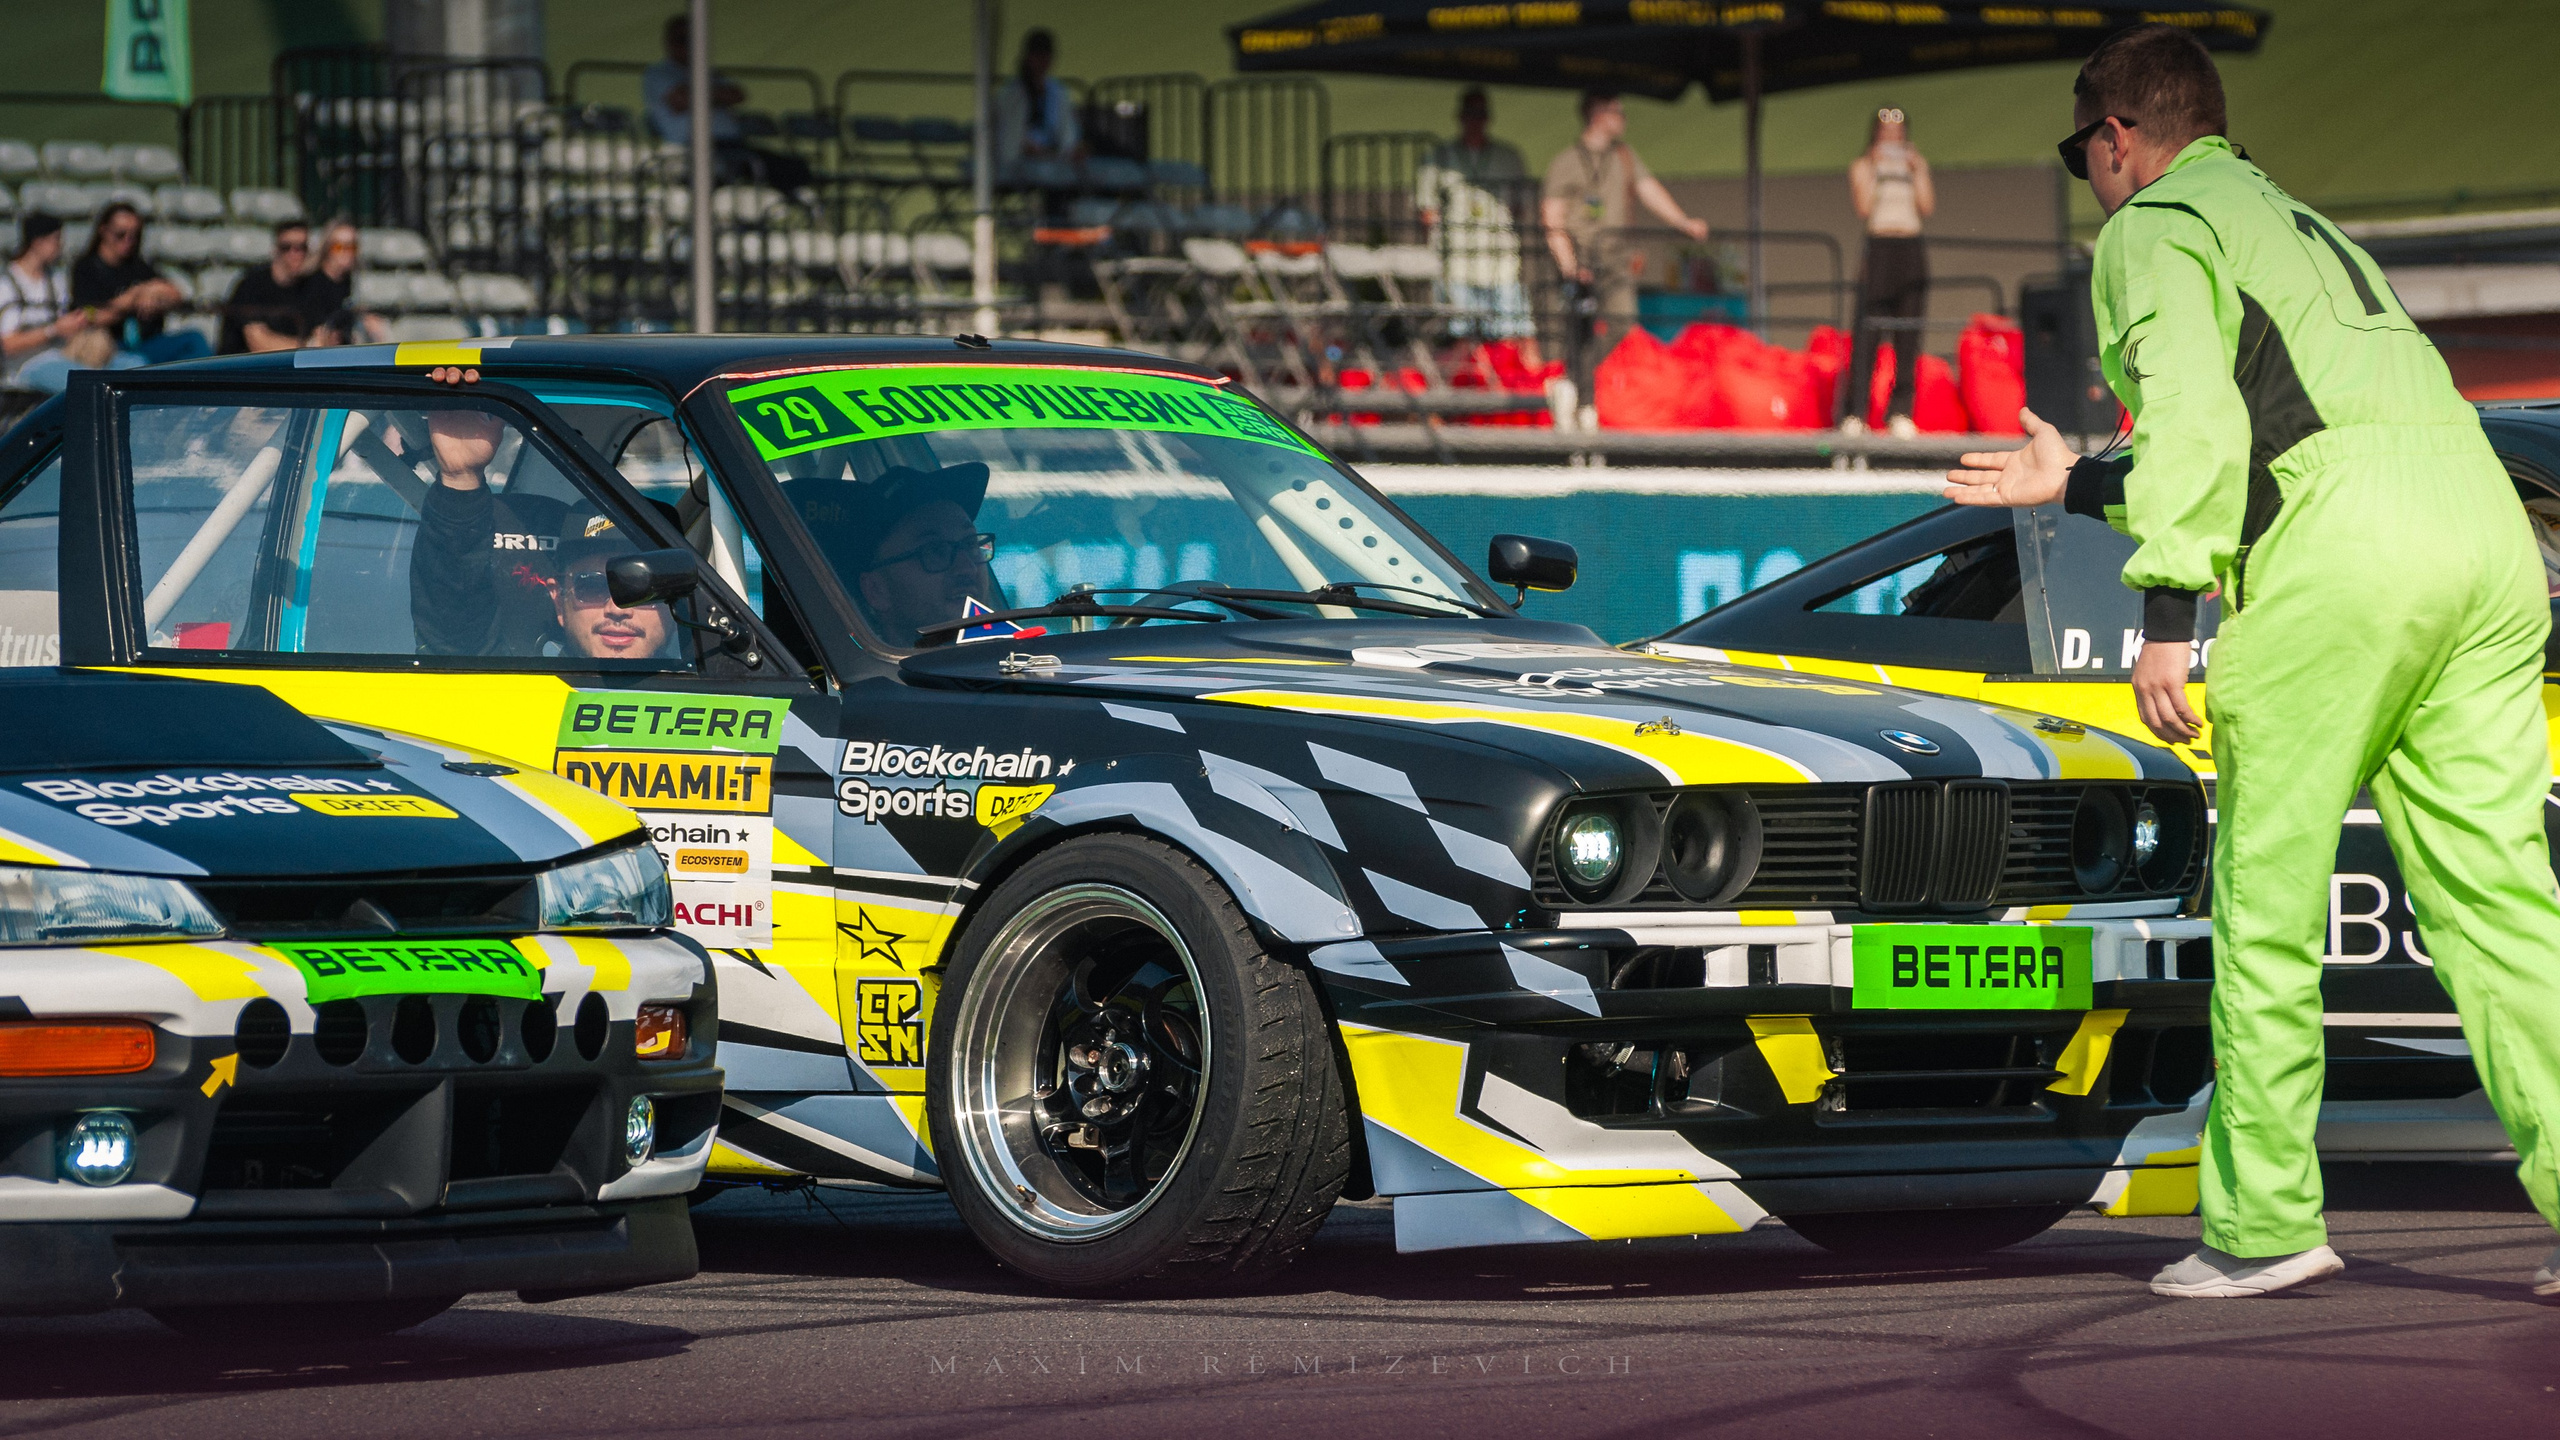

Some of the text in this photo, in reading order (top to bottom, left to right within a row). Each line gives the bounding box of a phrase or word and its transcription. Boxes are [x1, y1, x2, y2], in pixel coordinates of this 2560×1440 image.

[757, 384, 1225, 440] 29 БОЛТРУШЕВИЧ
[841, 740, 1052, 779] Blockchain
[22, 773, 369, 801] Blockchain
[839, 780, 1045, 822] Sports DRIFT
[76, 794, 430, 827] Sports DRIFT
[681, 855, 744, 867] ECOSYSTEM
